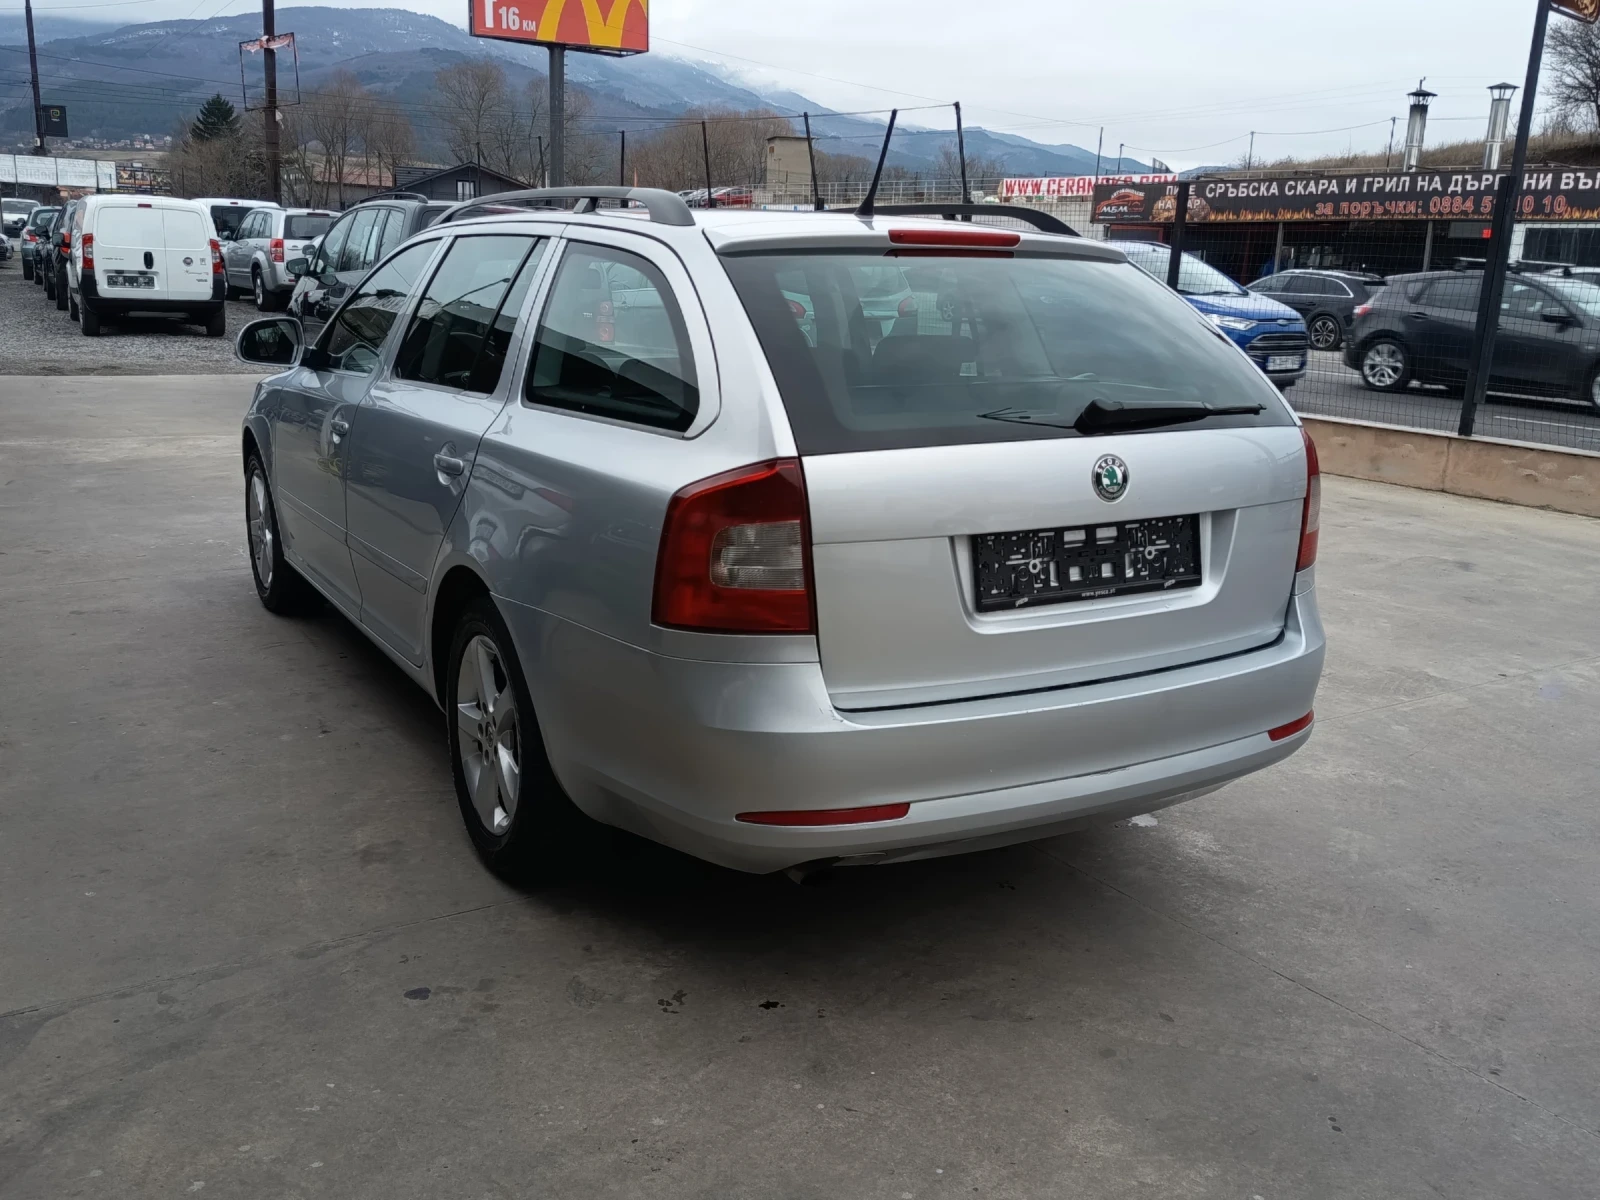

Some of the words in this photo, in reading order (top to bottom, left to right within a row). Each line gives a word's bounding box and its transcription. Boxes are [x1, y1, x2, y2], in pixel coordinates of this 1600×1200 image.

[498, 6, 520, 30] 16
[1166, 185, 1196, 196] ПИЕ
[1205, 181, 1279, 198] СРЪБСКА
[1284, 179, 1339, 195] СКАРА
[1345, 178, 1357, 194] И
[1362, 176, 1410, 193] ГРИЛ
[1416, 175, 1442, 192] НА
[1447, 173, 1553, 194] ДЪРНИ
[1159, 200, 1172, 210] НА
[1315, 202, 1334, 215] за
[1339, 201, 1423, 217] поръчки:
[1429, 196, 1474, 214] 0884
[1542, 194, 1566, 214] 10
